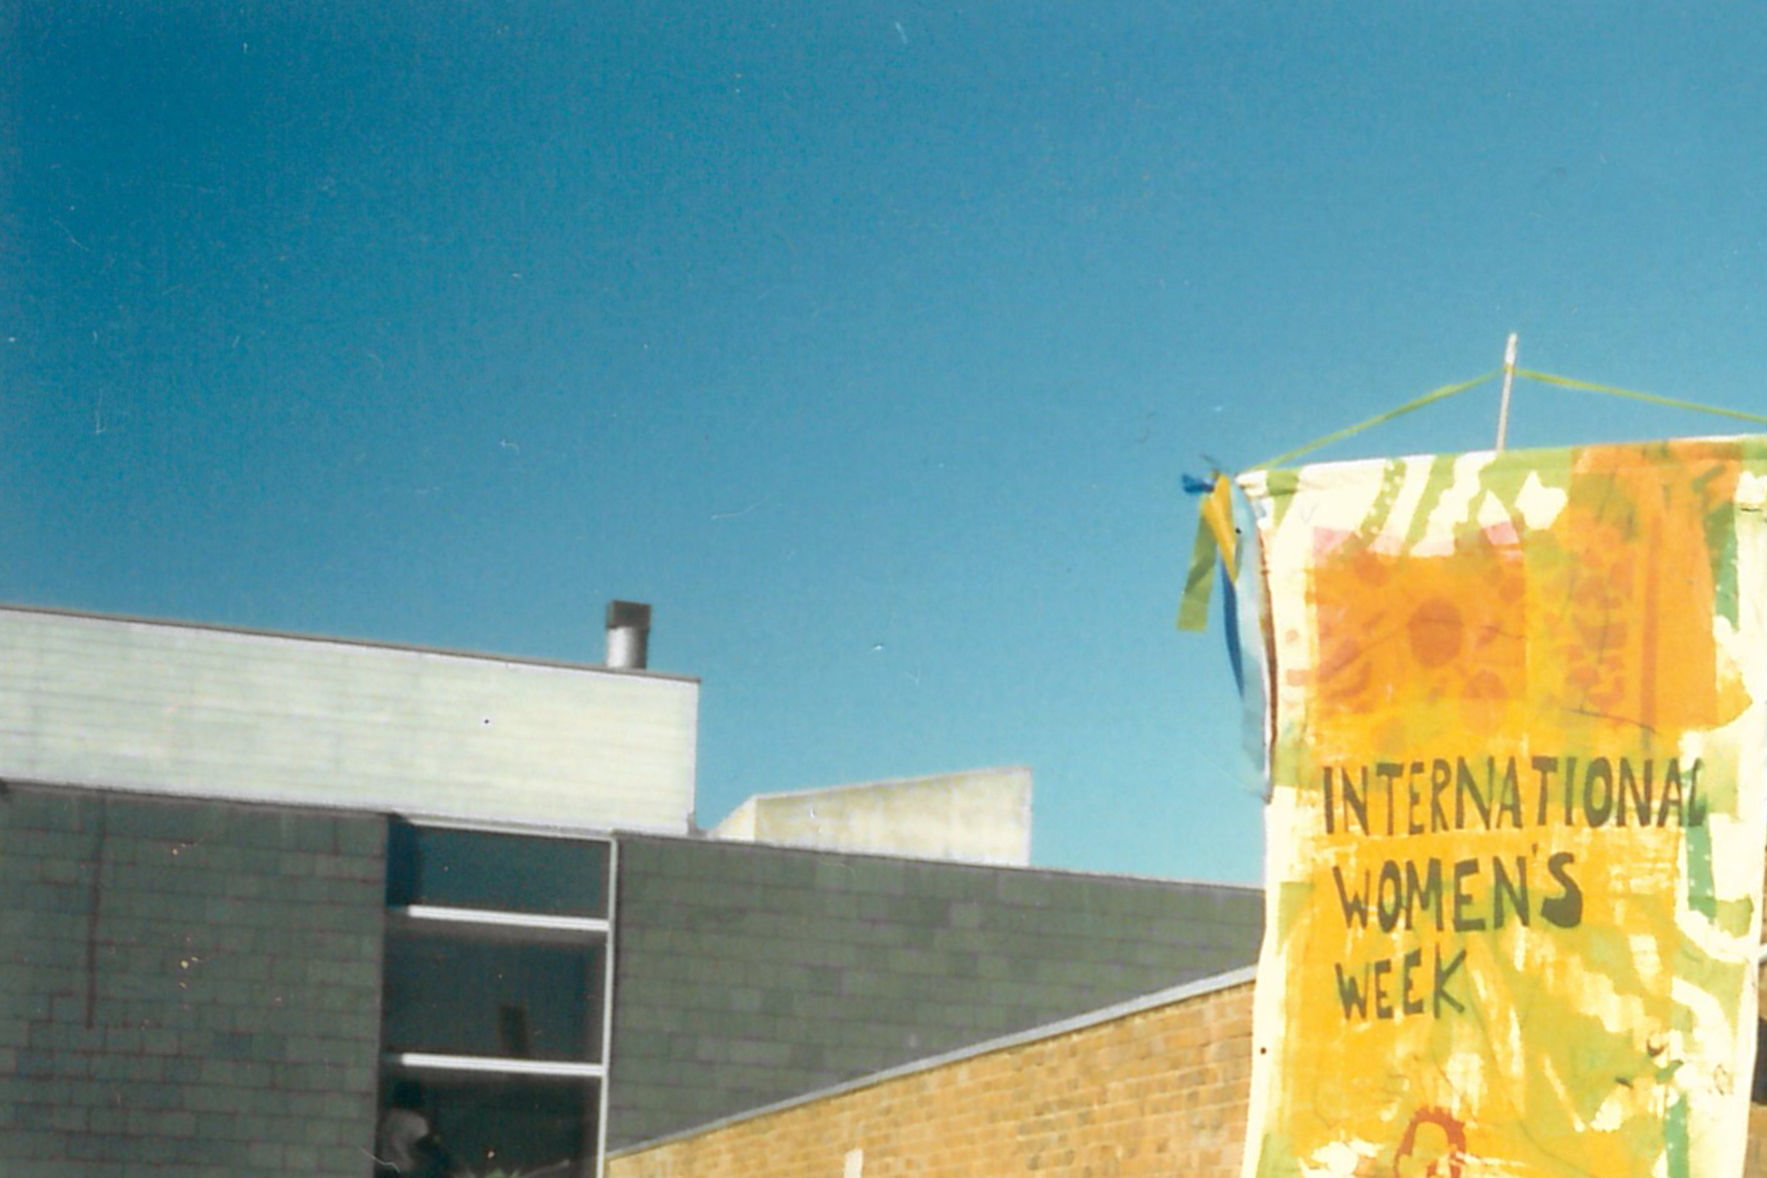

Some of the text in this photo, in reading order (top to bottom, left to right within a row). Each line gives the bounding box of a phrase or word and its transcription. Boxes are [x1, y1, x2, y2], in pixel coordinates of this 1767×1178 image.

[1323, 756, 1707, 836] INTERNATIONAL
[1333, 844, 1583, 932] WOMEN'S
[1335, 945, 1468, 1020] WEEK
